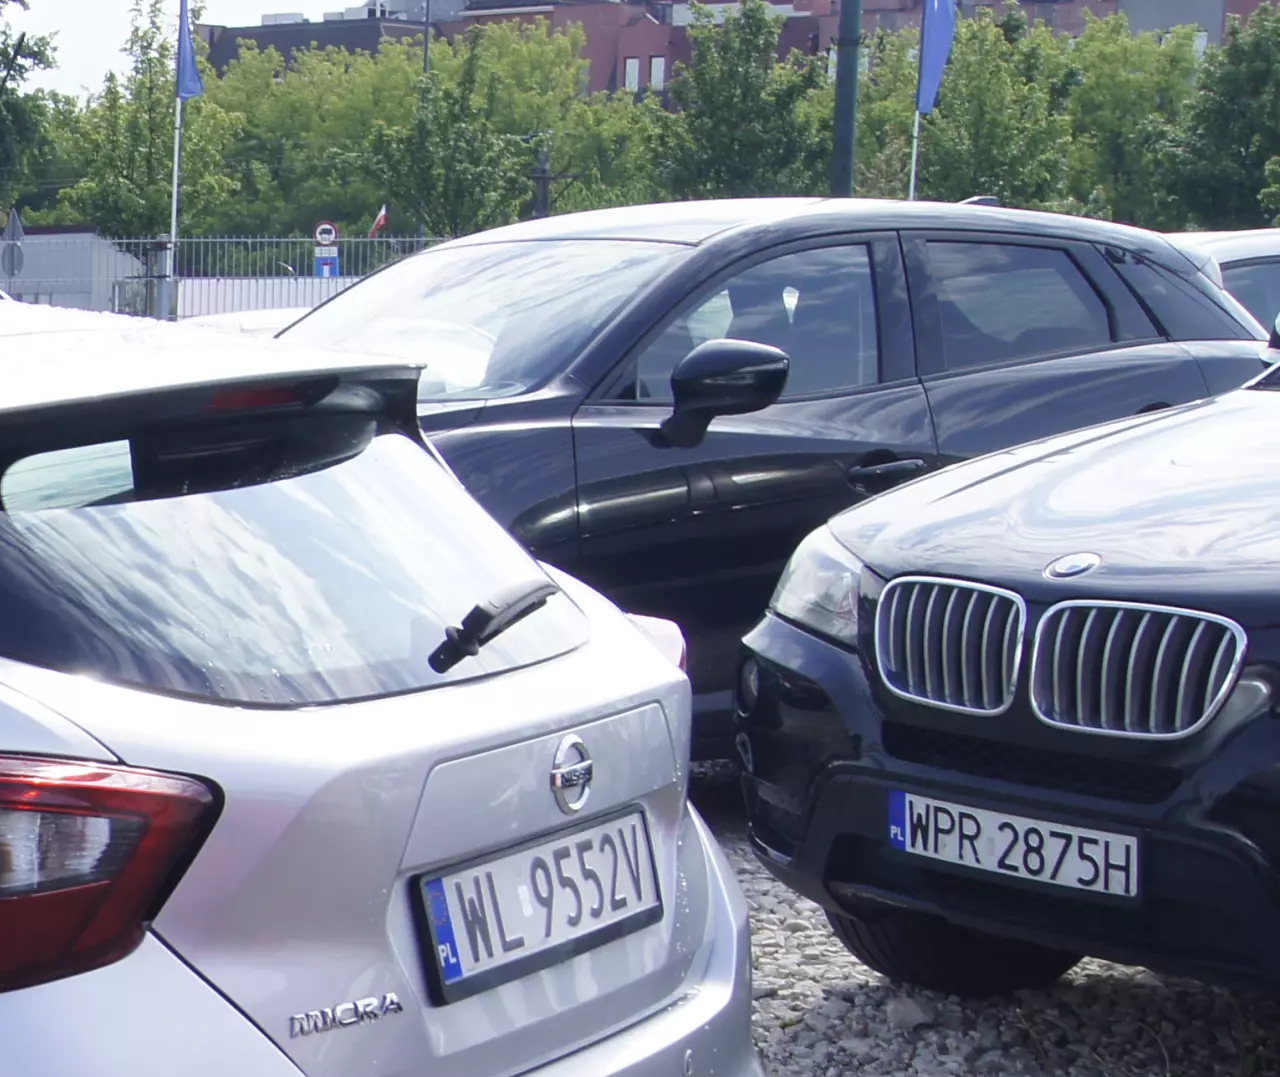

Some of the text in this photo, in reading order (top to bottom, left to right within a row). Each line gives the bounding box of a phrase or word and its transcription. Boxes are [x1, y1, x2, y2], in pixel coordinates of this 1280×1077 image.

[890, 825, 905, 842] PL
[908, 799, 1132, 895] WPR 2875H
[454, 823, 643, 964] WL 9552V
[438, 944, 457, 967] PL
[289, 992, 403, 1039] MICRA
